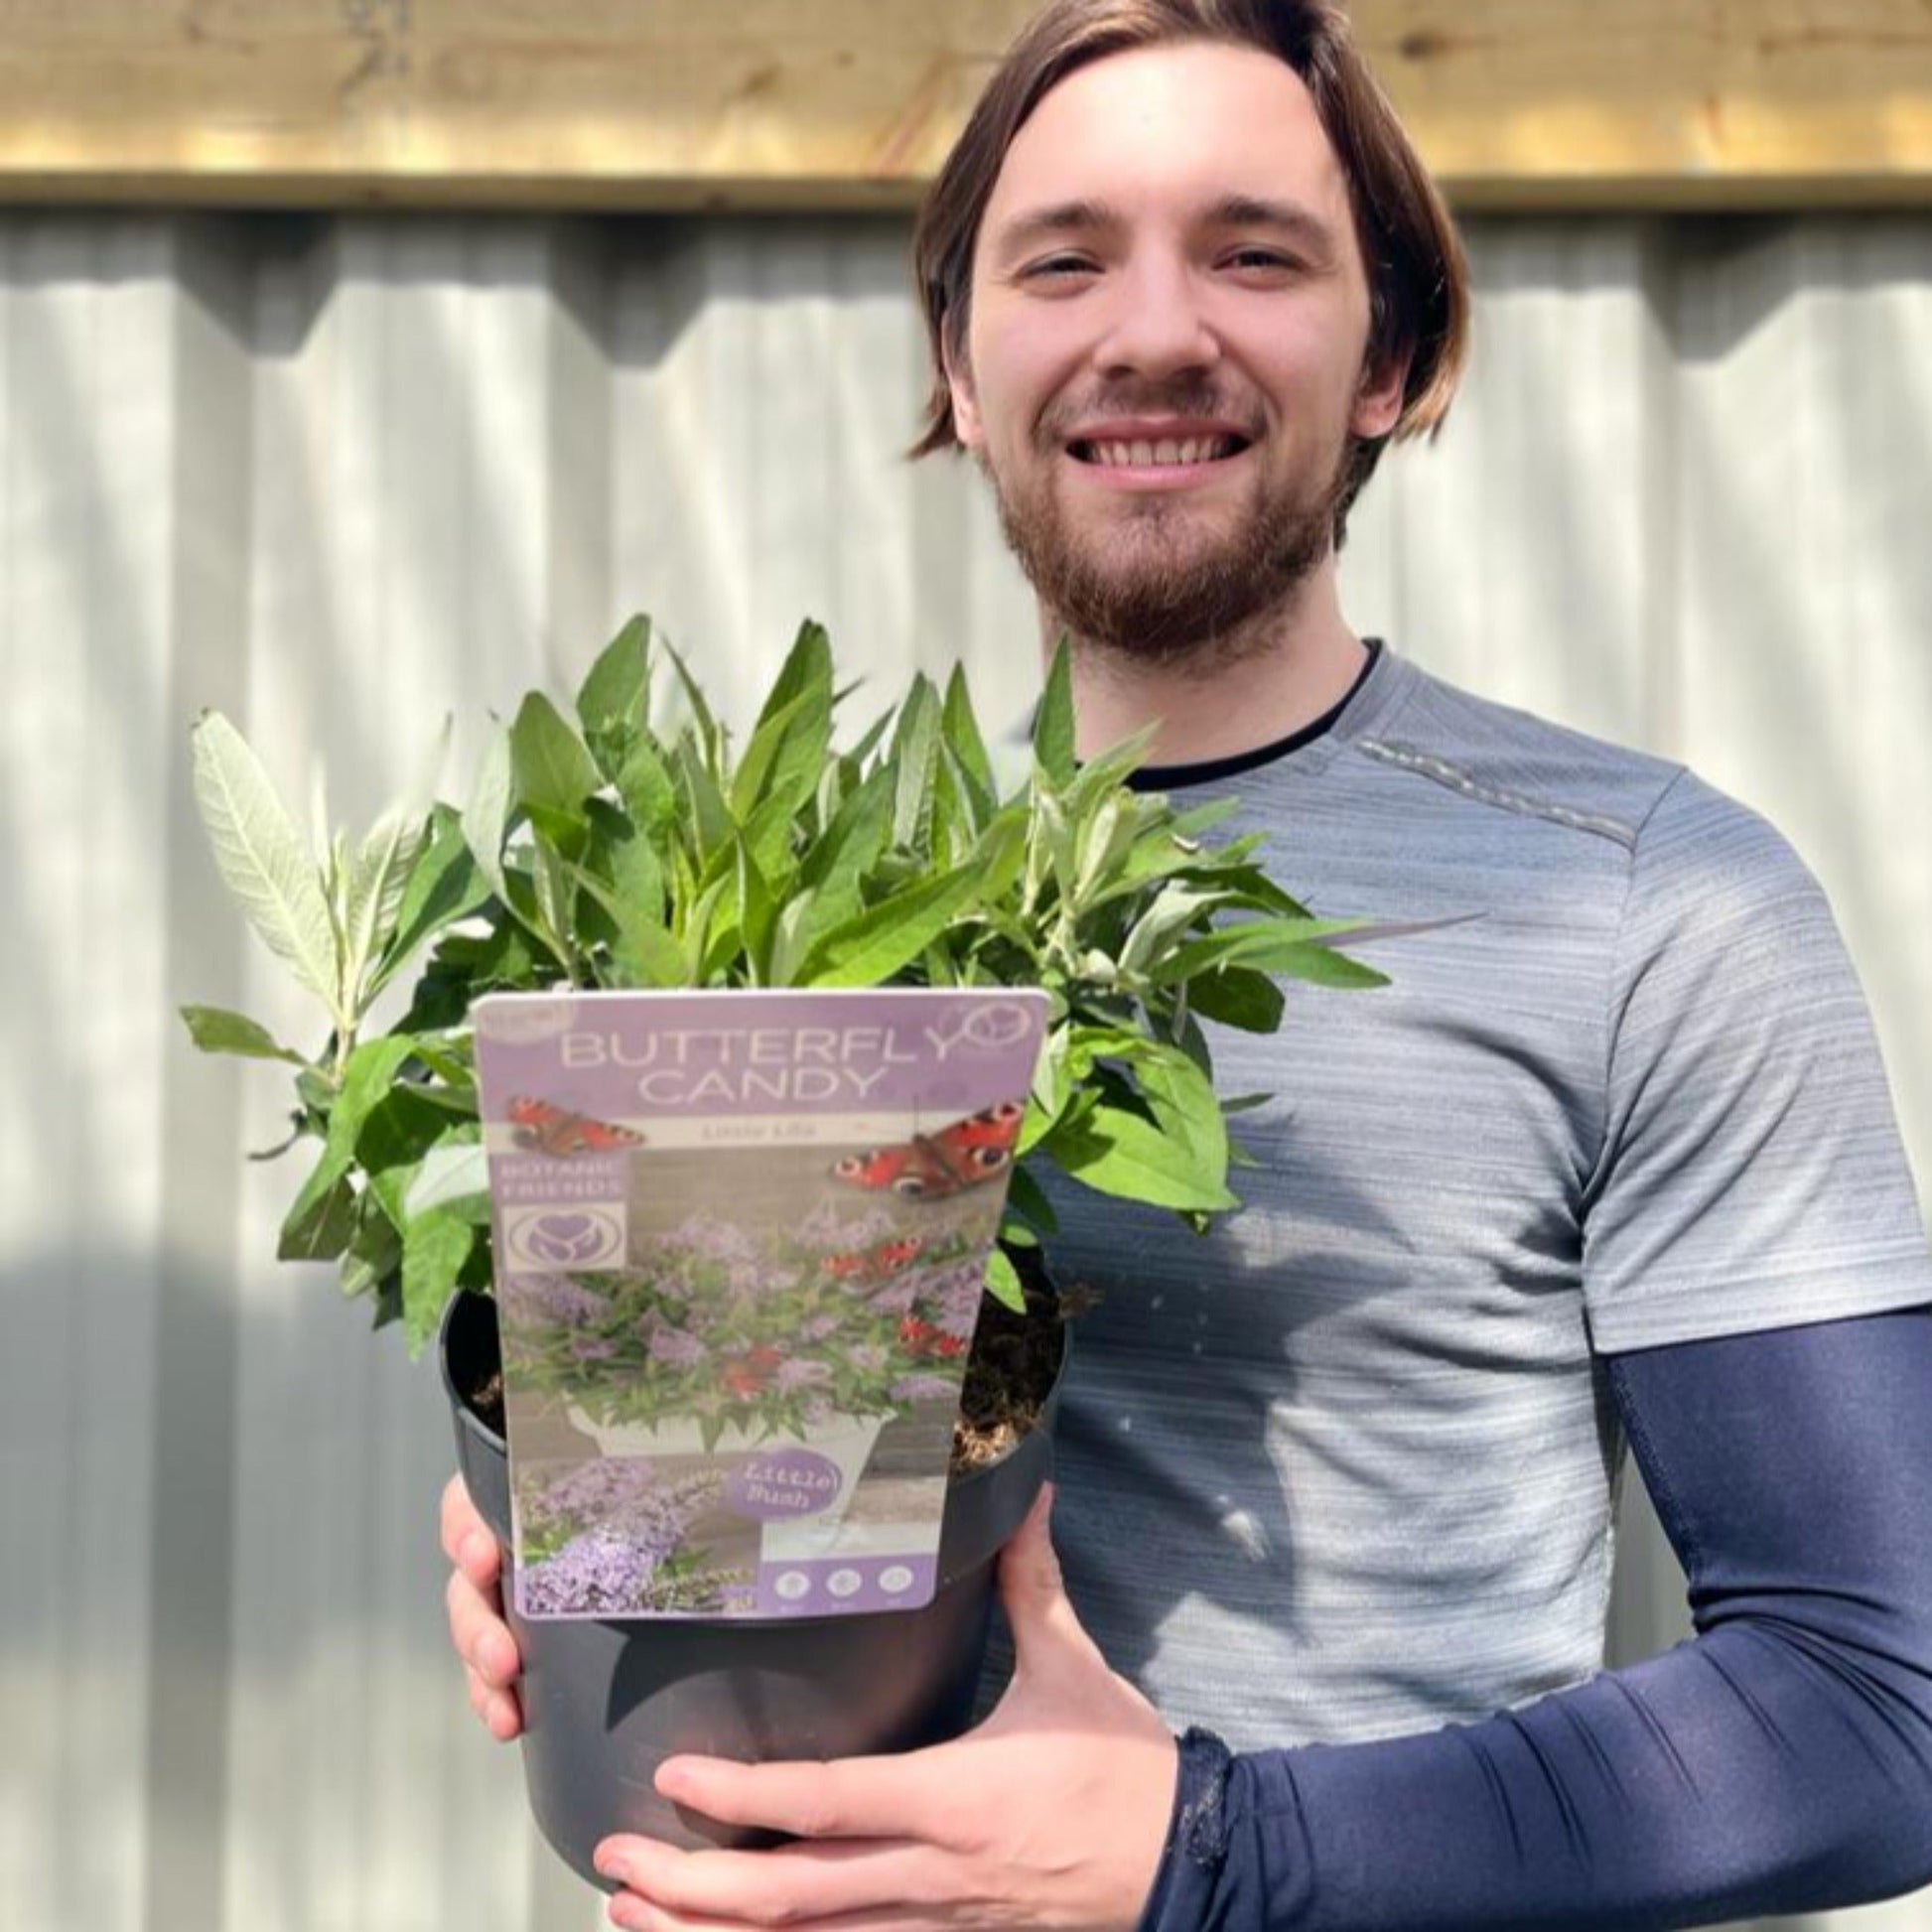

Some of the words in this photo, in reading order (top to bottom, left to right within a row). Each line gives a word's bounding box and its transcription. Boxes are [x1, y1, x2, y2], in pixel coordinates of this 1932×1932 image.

[561, 1027, 965, 1068] BUTTERFLY
[638, 1067, 887, 1105] CANDY
[744, 1461, 831, 1490] Little
